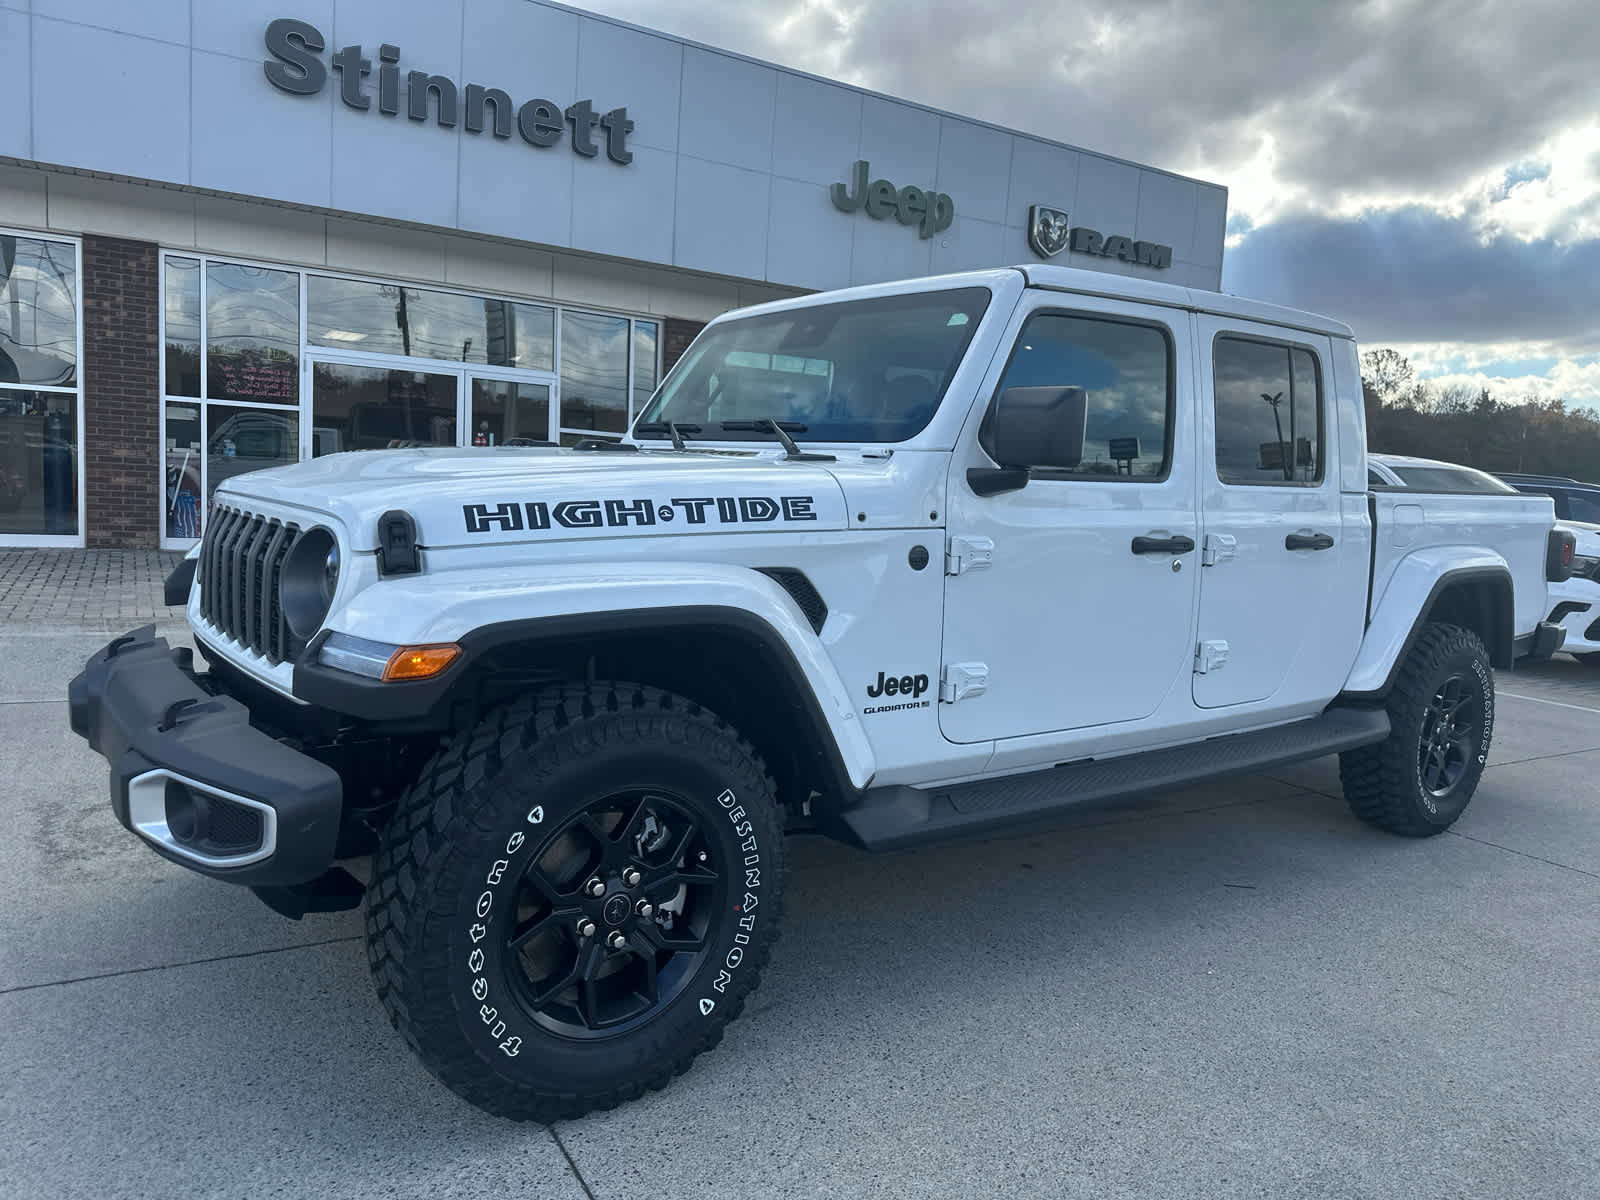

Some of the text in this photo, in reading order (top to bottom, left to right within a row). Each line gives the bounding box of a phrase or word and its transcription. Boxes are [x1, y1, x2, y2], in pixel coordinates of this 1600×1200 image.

[264, 18, 634, 165] Stinnett
[830, 160, 954, 240] Jeep
[1069, 226, 1173, 269] RAM
[463, 496, 817, 533] HIGH TIDE
[867, 671, 928, 699] Jeep
[863, 701, 920, 714] GLADIATOR
[713, 789, 761, 993] DESTINATION
